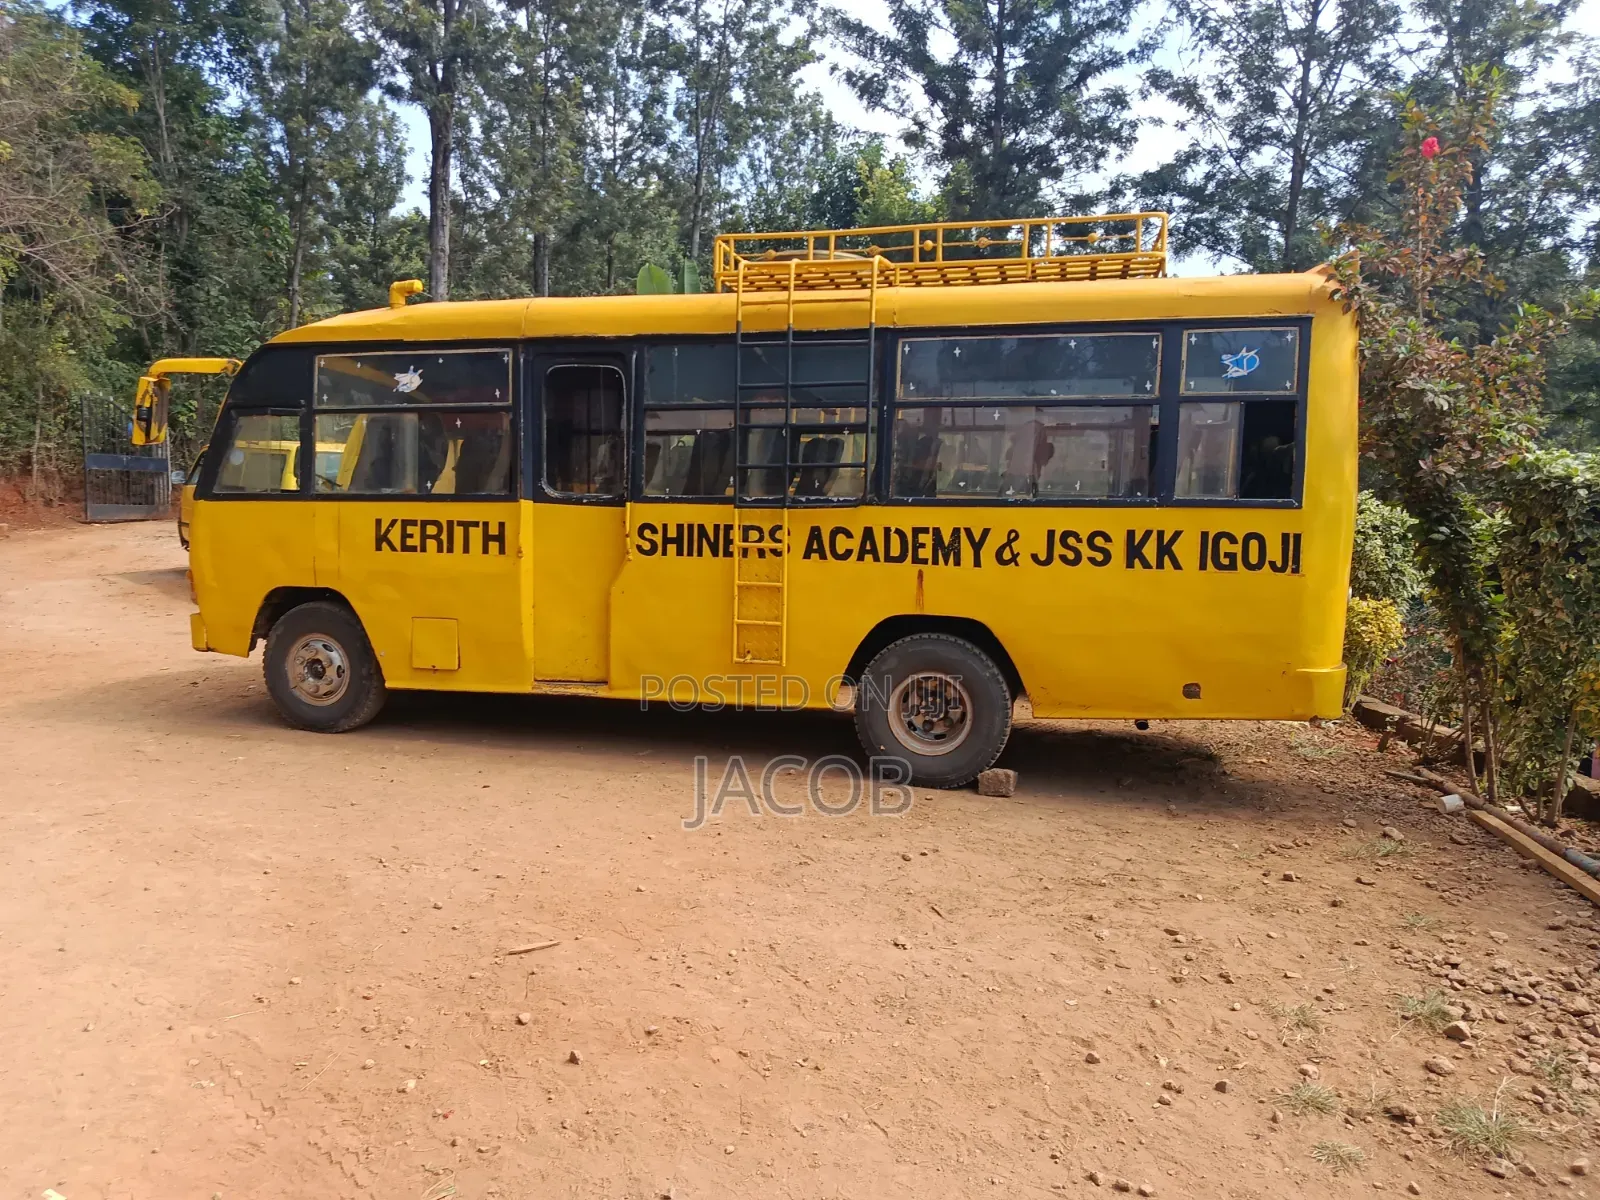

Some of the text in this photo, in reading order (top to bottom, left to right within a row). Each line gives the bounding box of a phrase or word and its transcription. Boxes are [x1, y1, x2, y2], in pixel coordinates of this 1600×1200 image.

[374, 518, 1303, 575] KERITH SHINERS ACADEMY & JSS KK IGOJI
